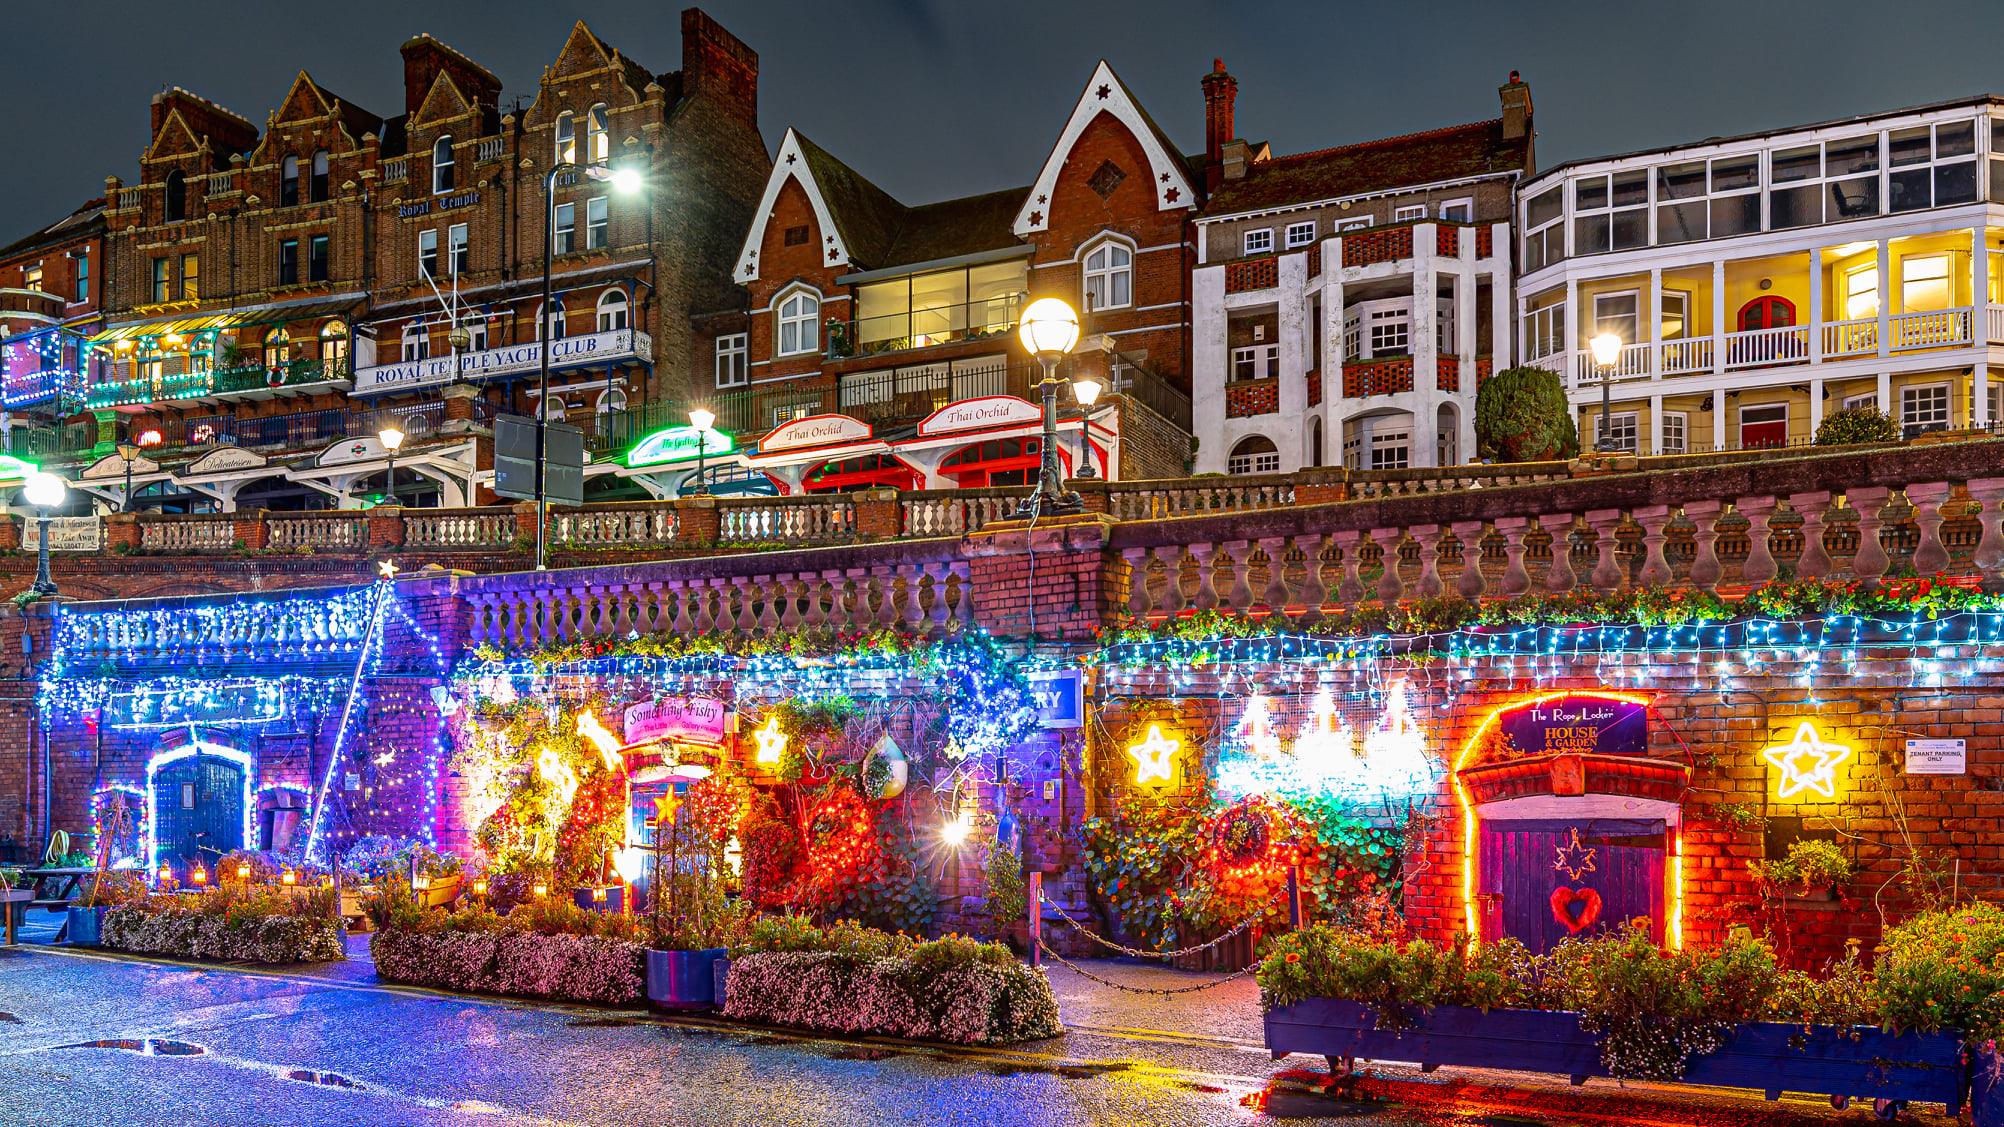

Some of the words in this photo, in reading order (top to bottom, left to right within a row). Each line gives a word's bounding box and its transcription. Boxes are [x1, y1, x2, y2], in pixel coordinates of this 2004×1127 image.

[399, 201, 430, 218] Royal
[439, 192, 480, 209] Temple
[375, 364, 425, 383] ROYAL
[495, 346, 542, 366] YACH
[552, 338, 596, 357] CLUB
[946, 409, 972, 423] Thai
[975, 402, 1013, 420] Orchid
[786, 427, 809, 441] Thai
[811, 420, 845, 437] Orchid
[203, 456, 253, 470] Delicatessen
[629, 701, 683, 725] Something
[688, 702, 718, 723] Fishy
[1530, 709, 1547, 722] The
[1552, 708, 1576, 722] Rope
[1582, 707, 1614, 720] Locker
[1545, 727, 1598, 738] HOUSE
[1545, 739, 1553, 747] &
